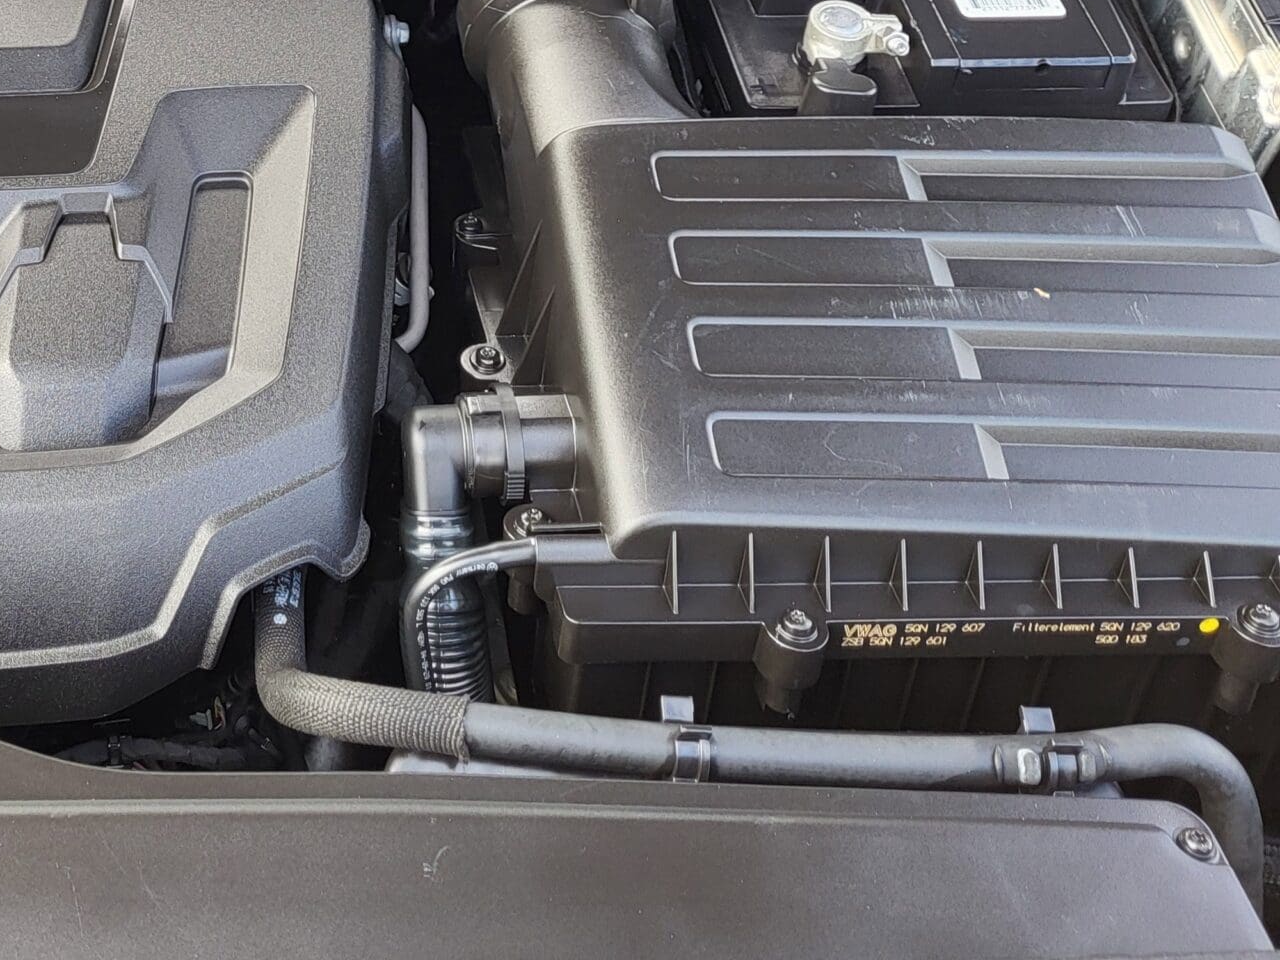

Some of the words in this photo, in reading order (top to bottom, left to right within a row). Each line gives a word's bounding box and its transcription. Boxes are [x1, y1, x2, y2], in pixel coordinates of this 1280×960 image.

[843, 623, 898, 637] VWAG
[904, 622, 929, 633] 5QN
[935, 622, 957, 633] 129
[961, 622, 986, 632] 607
[1012, 622, 1095, 632] Filterelement
[1099, 621, 1124, 632] 5QN
[1130, 621, 1152, 631] 129
[1156, 621, 1181, 631] 620
[841, 636, 864, 647] ZSB
[869, 636, 893, 646] 5QN
[900, 636, 921, 646] 129
[925, 635, 947, 645] 601
